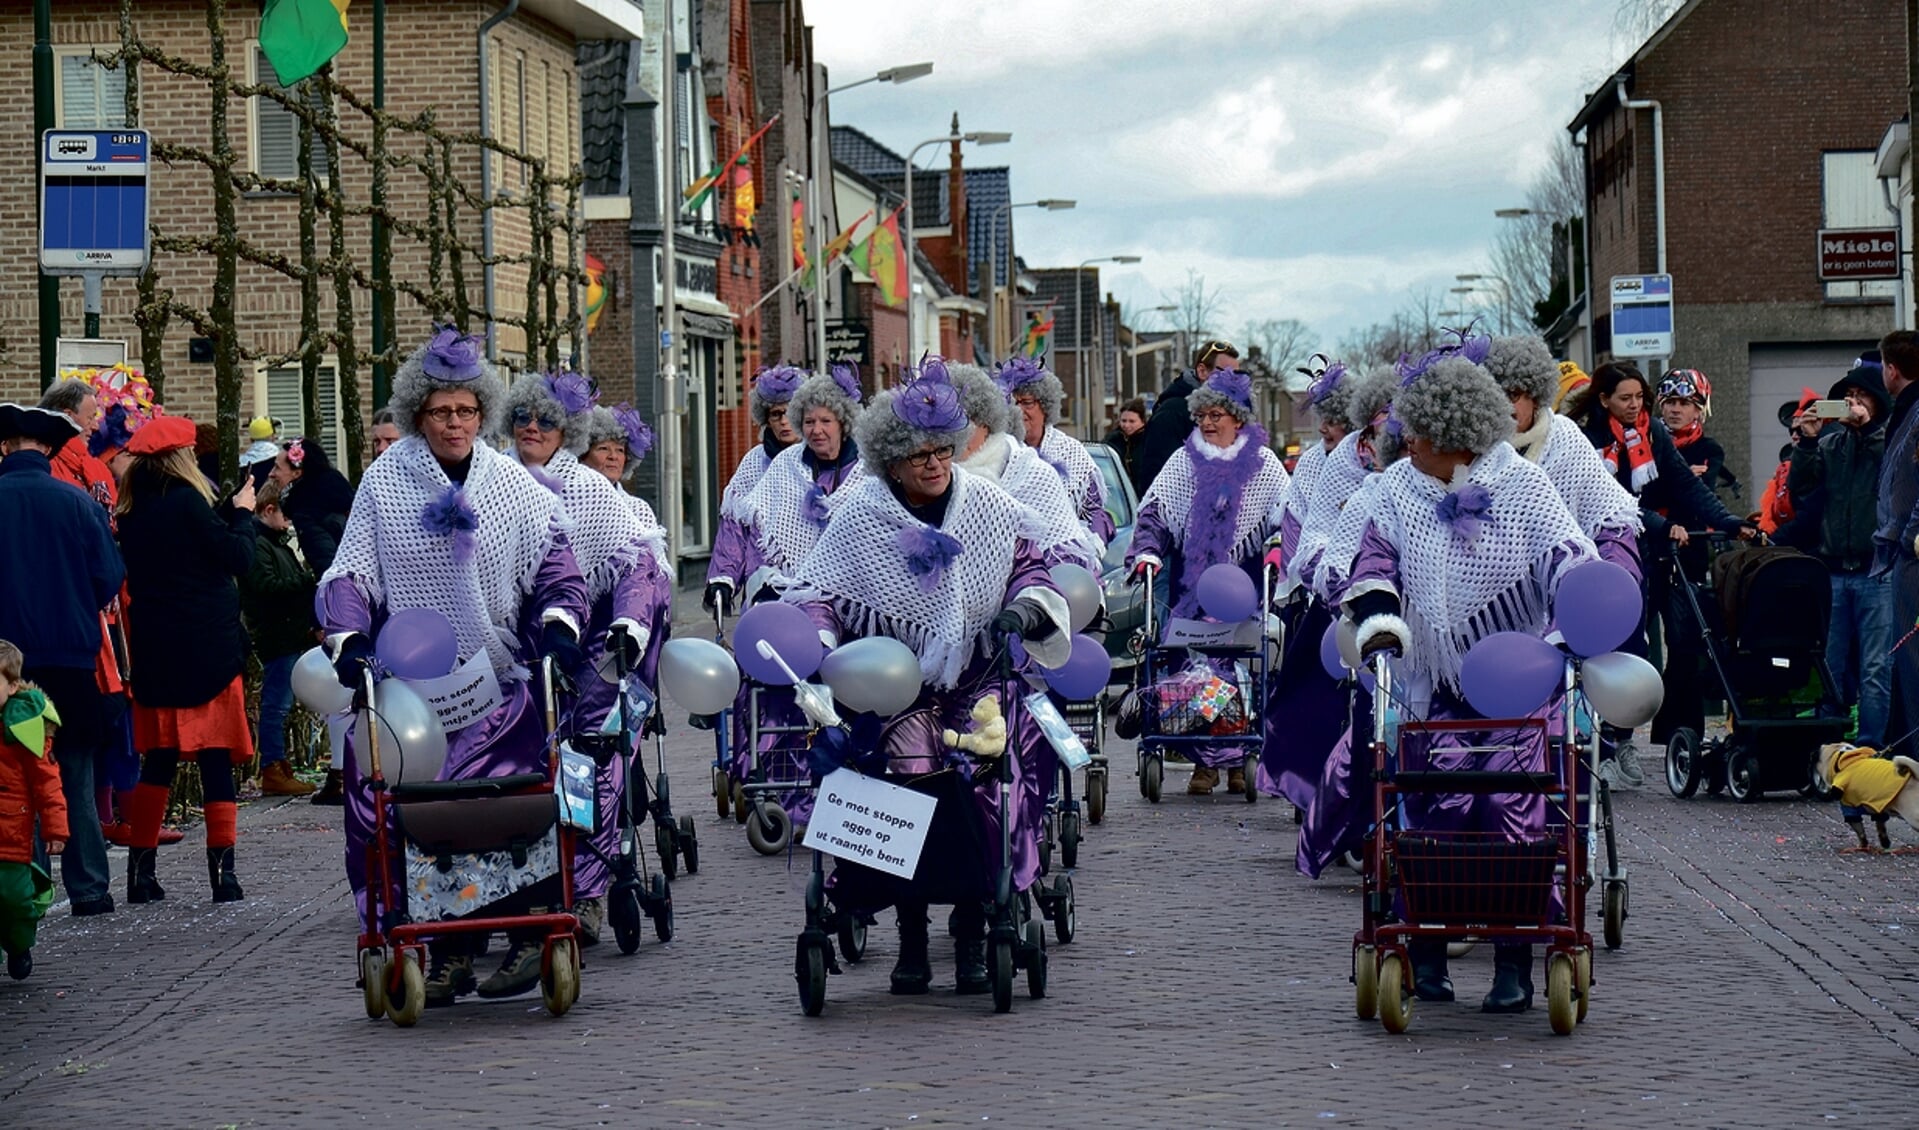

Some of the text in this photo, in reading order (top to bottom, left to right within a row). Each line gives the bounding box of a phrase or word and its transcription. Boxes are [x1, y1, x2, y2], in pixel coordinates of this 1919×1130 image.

[1823, 239, 1895, 254] Miele
[85, 252, 112, 260] ARRIVA
[1843, 260, 1865, 272] geen
[461, 697, 475, 708] op
[471, 697, 494, 716] bent
[827, 792, 915, 830] Ge mot stoppe
[842, 820, 891, 844] agge op
[816, 831, 906, 867] ut raantje bent
